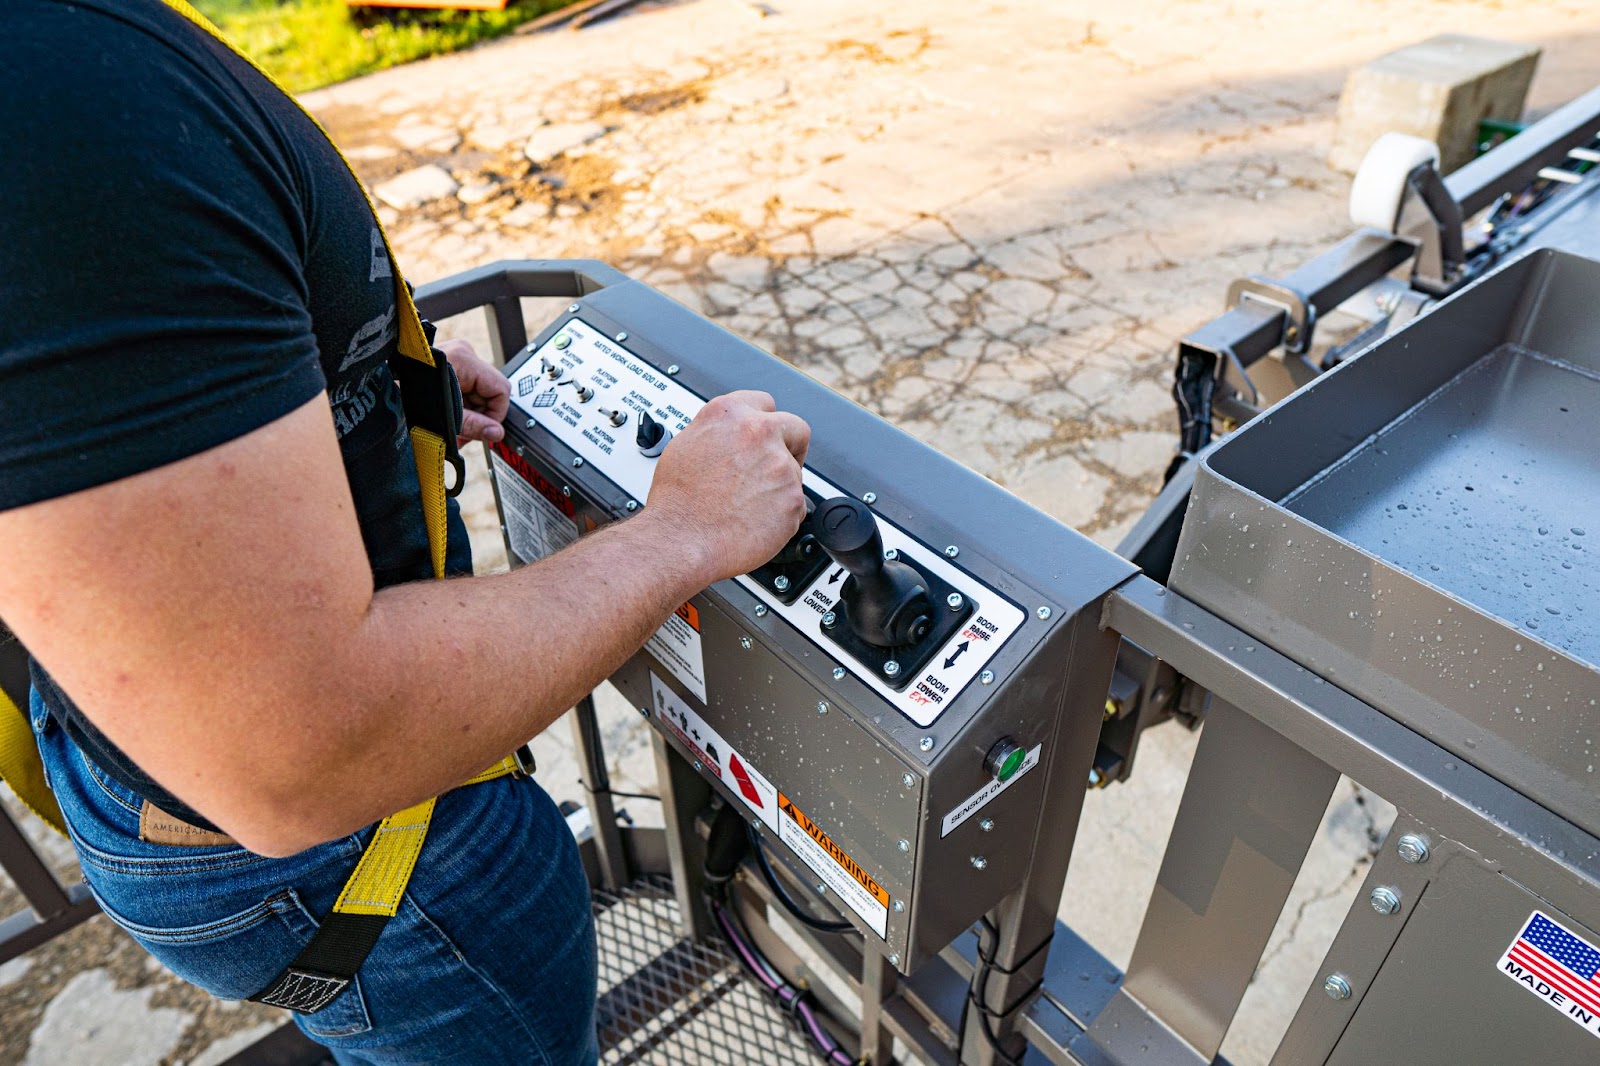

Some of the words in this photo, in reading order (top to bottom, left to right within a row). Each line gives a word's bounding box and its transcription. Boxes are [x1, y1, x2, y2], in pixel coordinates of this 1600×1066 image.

[560, 358, 574, 370] ROTATE
[564, 349, 584, 365] PLATFORM
[594, 340, 612, 354] RATED
[610, 351, 628, 365] WORK
[626, 362, 644, 376] LOAD
[642, 372, 656, 384] 600
[654, 380, 668, 392] LBS
[590, 375, 604, 386] LEVEL
[596, 368, 618, 384] PLATFORM
[622, 396, 634, 407] AUTO
[632, 402, 646, 413] LEVE
[630, 390, 653, 408] PLATFORM
[552, 406, 564, 418] LEVEL
[564, 416, 578, 428] DOWN
[561, 402, 582, 420] PLATFORM
[655, 408, 670, 420] MAIN
[666, 404, 684, 418] POWER
[582, 429, 600, 446] MANUAL
[598, 442, 612, 456] LEVEL
[592, 426, 616, 445] PLATFORM
[804, 596, 827, 616] LOWER
[812, 589, 832, 606] BOOM
[969, 624, 992, 642] RAISE
[976, 616, 999, 634] BOOM
[916, 682, 943, 704] LOWER
[926, 674, 950, 694] BOOM
[951, 791, 988, 824] SENSOR
[153, 823, 207, 835] AMERICAN
[802, 816, 880, 897] WARNING
[1504, 961, 1566, 1006] MADE
[1569, 1005, 1593, 1024] IN
